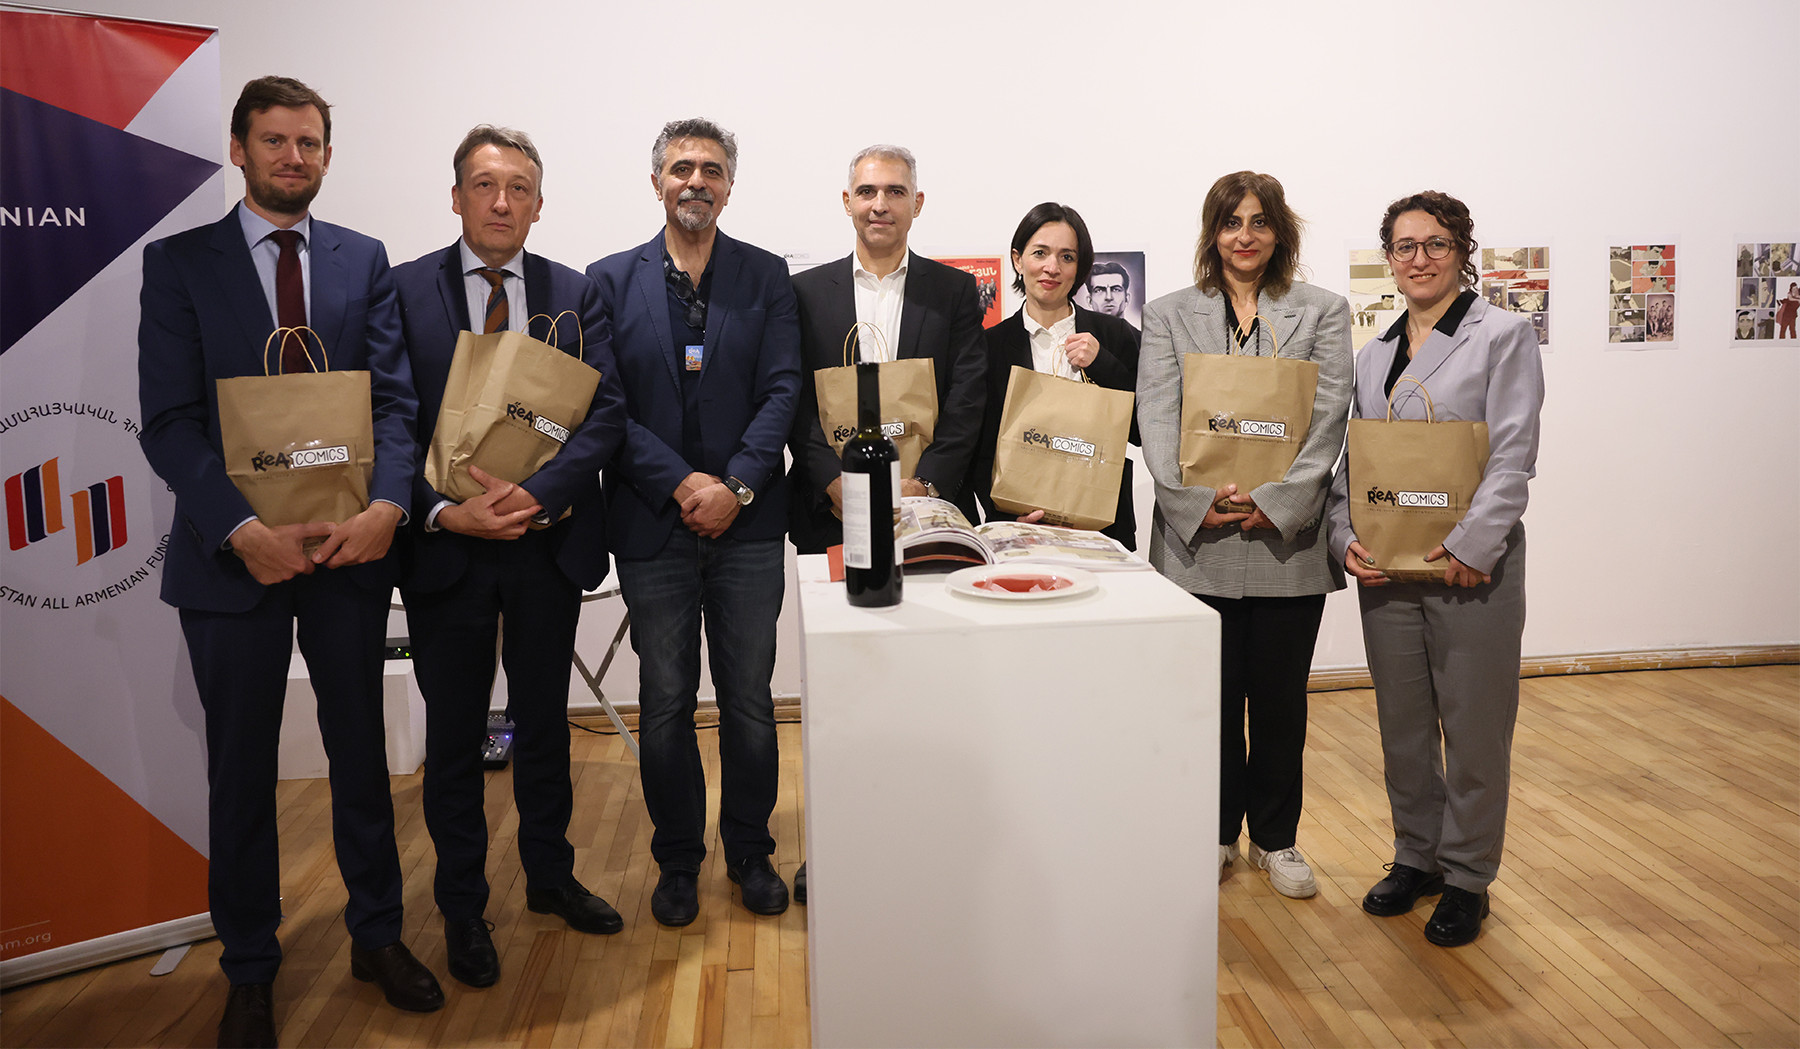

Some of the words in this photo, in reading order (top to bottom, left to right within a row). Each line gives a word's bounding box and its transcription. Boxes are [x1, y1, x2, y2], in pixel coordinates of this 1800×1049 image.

[0, 206, 86, 227] NIAN
[536, 418, 570, 441] COMICS
[1242, 421, 1283, 435] COMICS
[1054, 438, 1093, 455] COMICS
[295, 448, 346, 466] COMICS
[1400, 493, 1446, 506] COMICS
[41, 597, 70, 610] ALL
[75, 566, 149, 608] ARMENIAN
[146, 533, 171, 569] FUND
